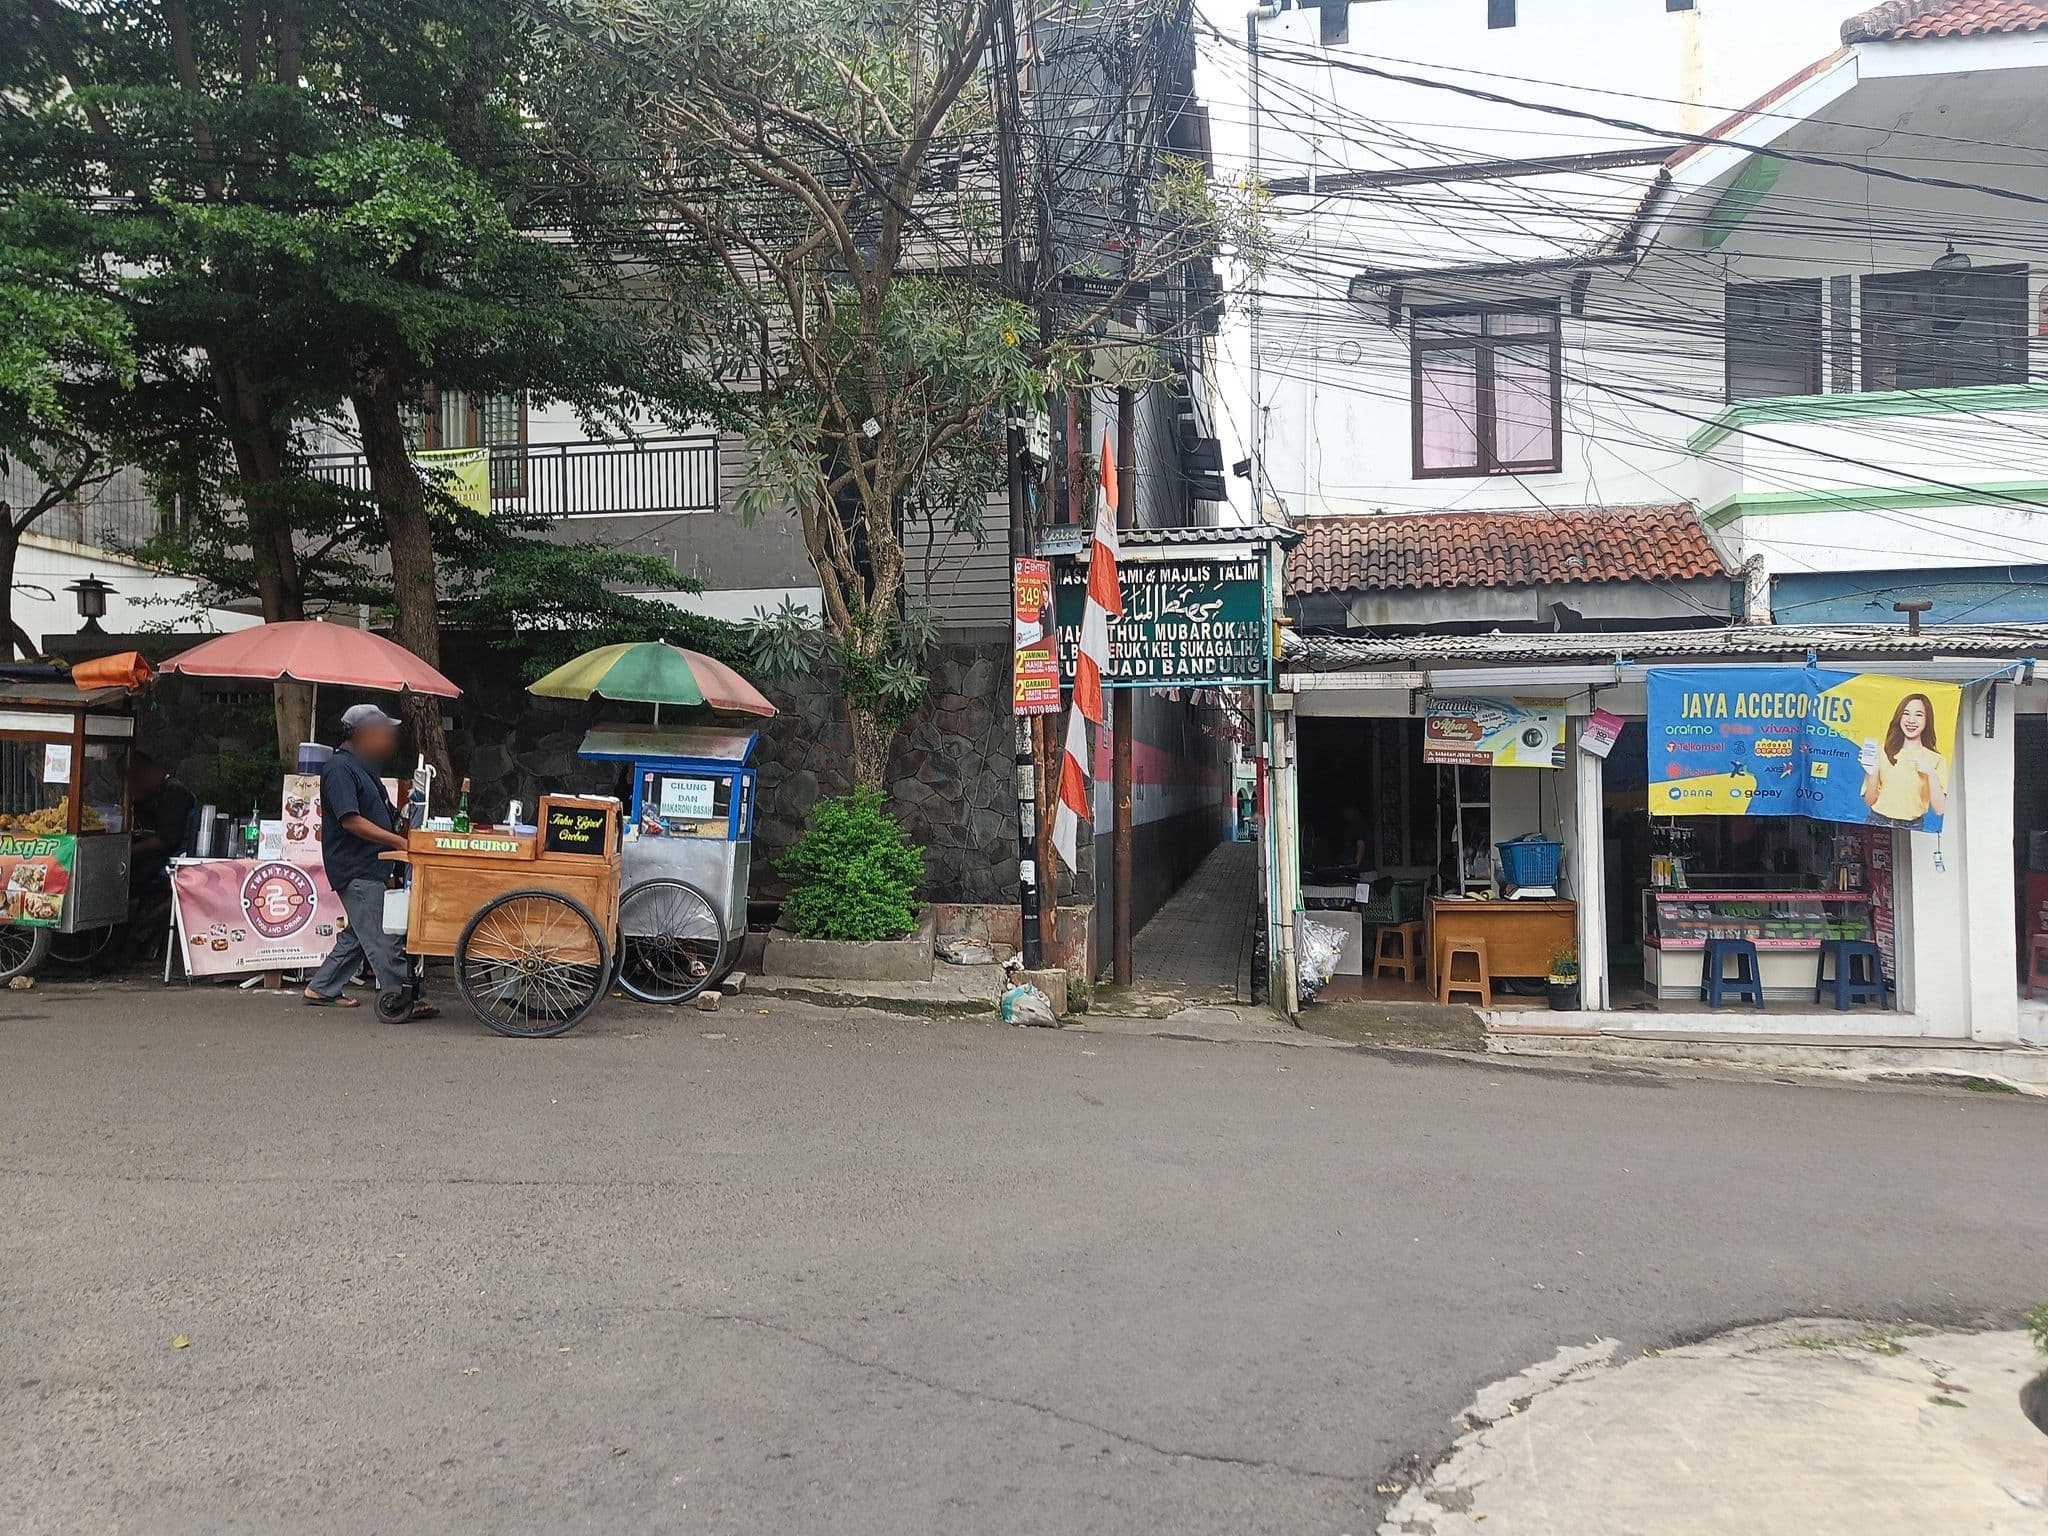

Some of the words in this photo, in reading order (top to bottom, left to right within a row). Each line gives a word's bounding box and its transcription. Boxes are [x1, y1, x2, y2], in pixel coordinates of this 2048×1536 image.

[1146, 567, 1156, 583] &
[1160, 565, 1211, 582] MAJLIS
[1155, 621, 1260, 641] MUBAROKAH
[1151, 641, 1176, 658] KEL
[1161, 656, 1260, 676] BANDUNG
[1681, 691, 1728, 719] JAYA
[1734, 691, 1853, 723] ACCECORIES
[1665, 724, 1713, 736] oraimo
[1806, 725, 1861, 740] ROBOT
[1679, 742, 1725, 752] Telkomsel
[1808, 747, 1850, 759] smartfren
[670, 782, 708, 791] CILUNG
[1744, 789, 1783, 800] gopay
[678, 794, 698, 803] DAN
[661, 802, 692, 814] MAKARONI
[693, 804, 713, 816] BASAH
[550, 813, 574, 826] Tahu
[0, 835, 60, 860] Asgar
[435, 837, 468, 850] TAHU
[470, 839, 519, 852] GEJROT
[250, 867, 305, 890] TWENTYSIX
[283, 914, 303, 931] DRINK
